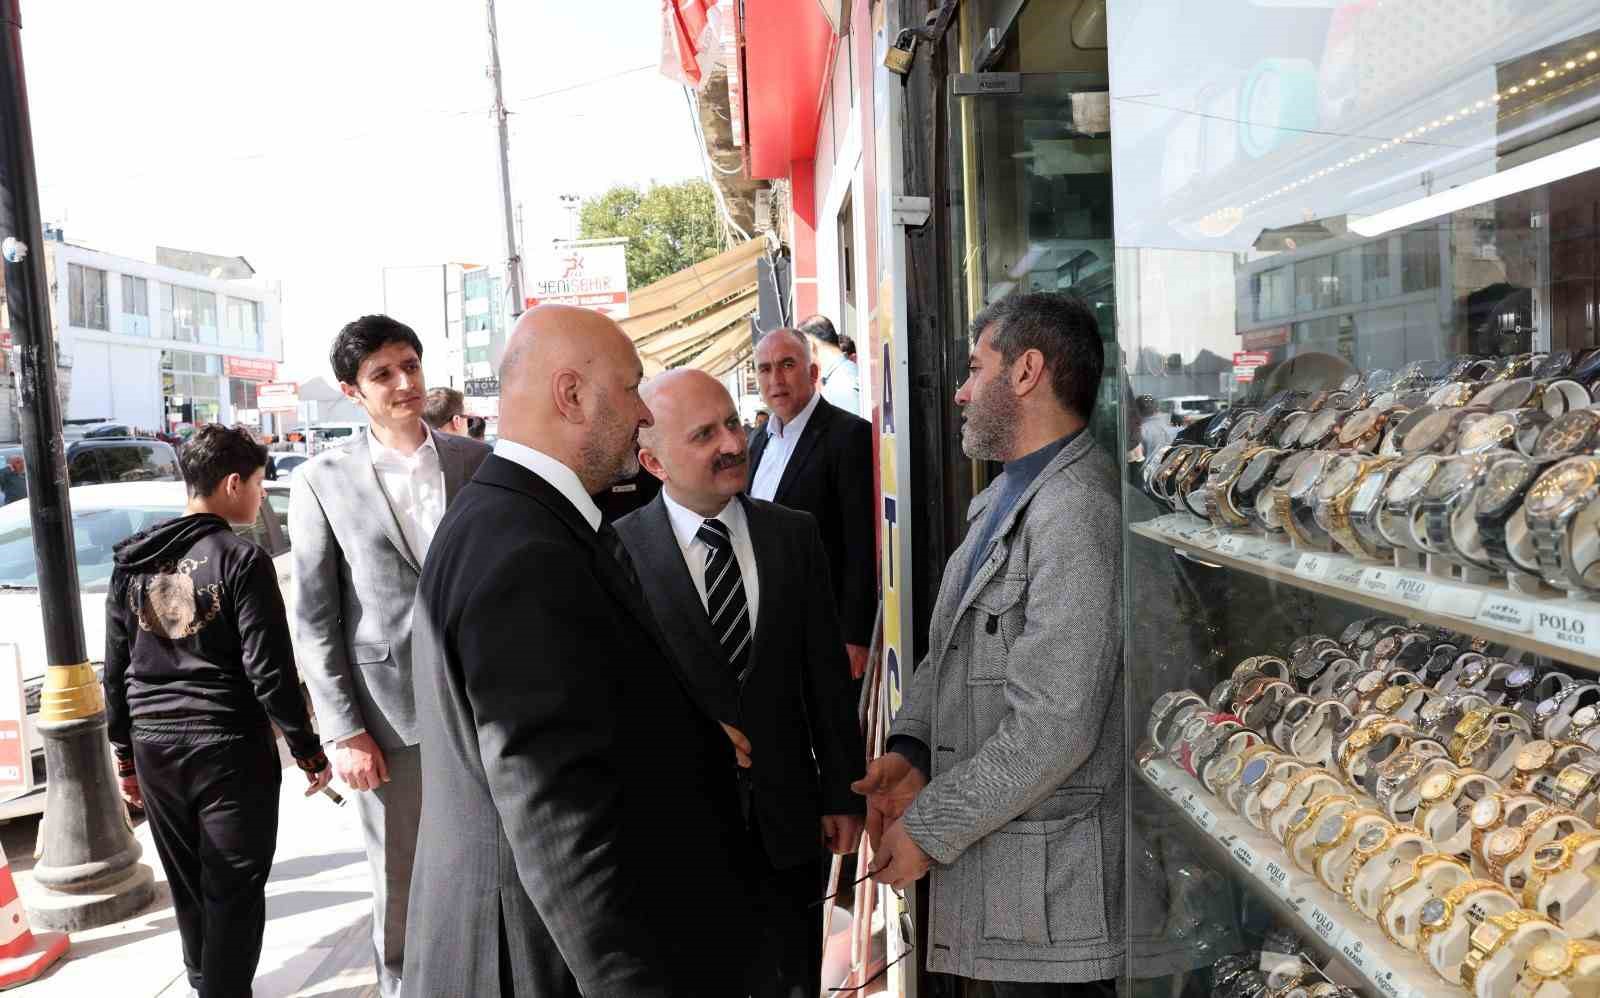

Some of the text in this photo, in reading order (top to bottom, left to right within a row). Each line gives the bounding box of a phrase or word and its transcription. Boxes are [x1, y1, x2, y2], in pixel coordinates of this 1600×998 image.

[1539, 612, 1584, 633] POLO
[1265, 862, 1287, 880] POLO
[1312, 908, 1335, 931] POLO
